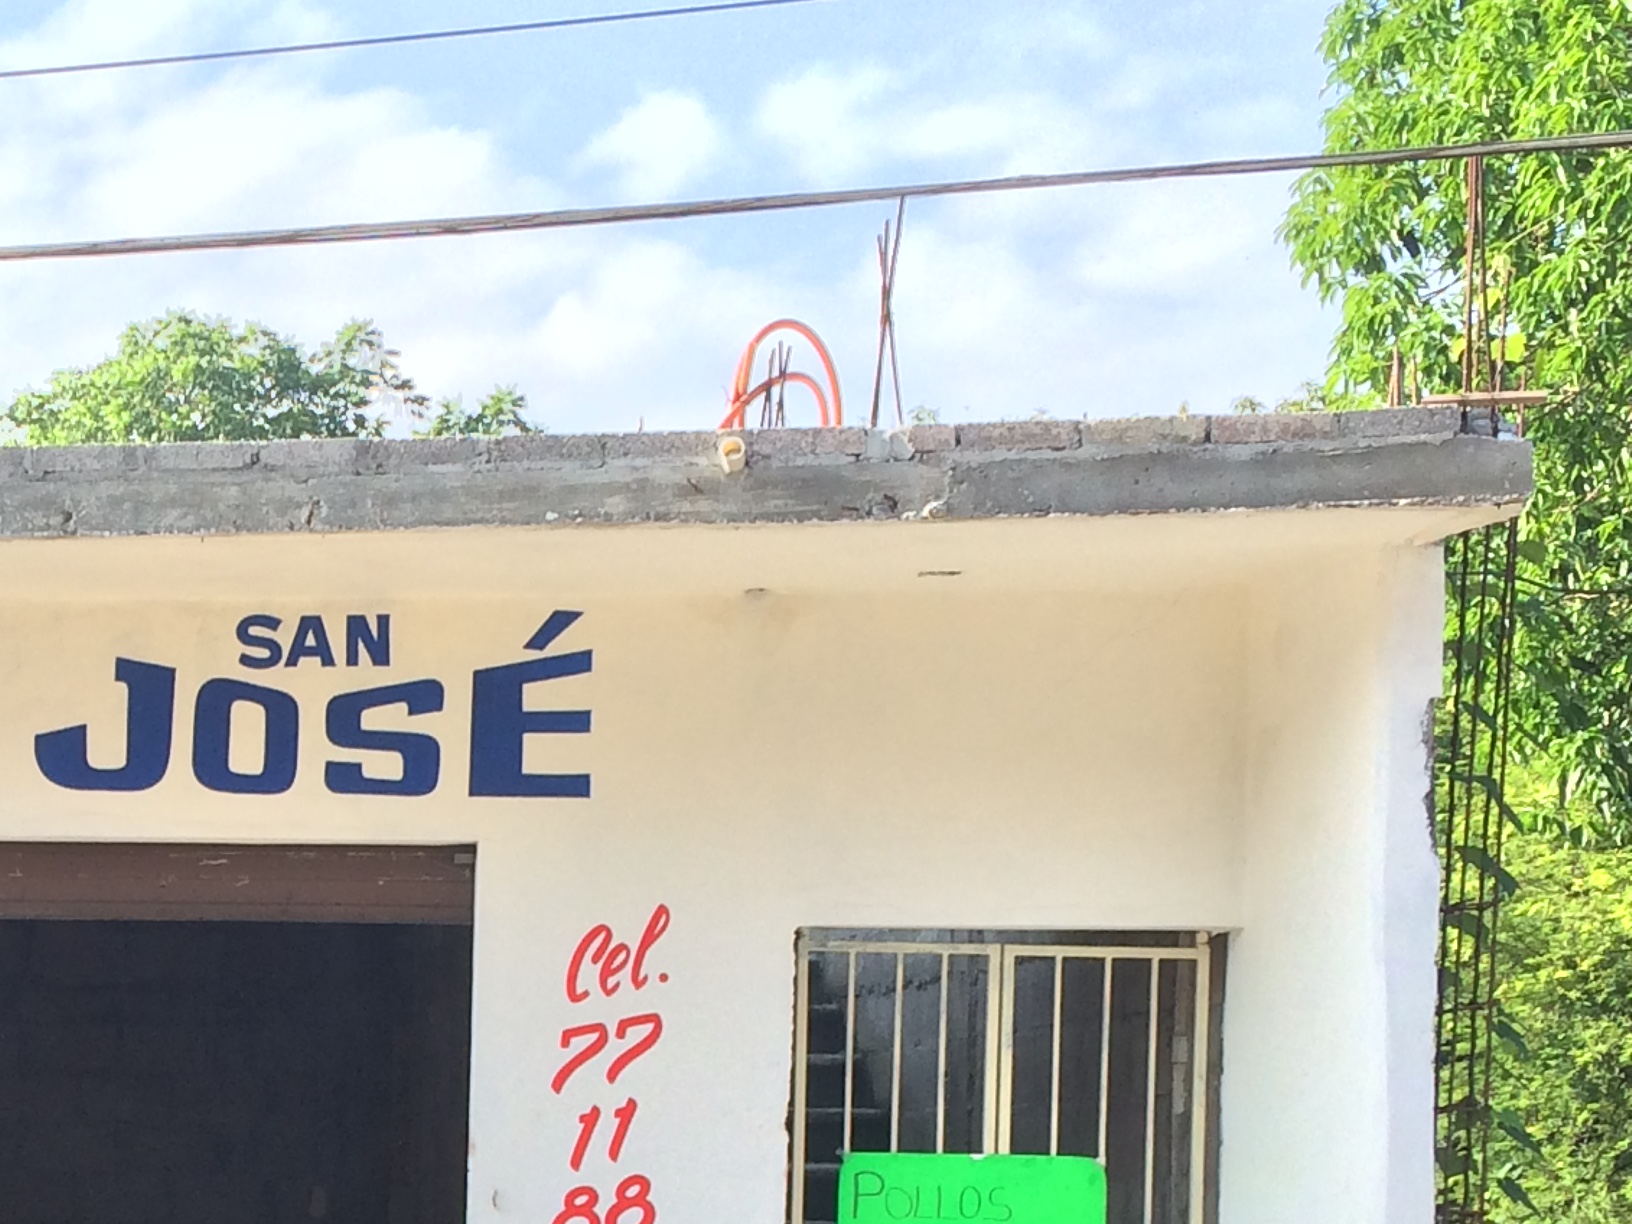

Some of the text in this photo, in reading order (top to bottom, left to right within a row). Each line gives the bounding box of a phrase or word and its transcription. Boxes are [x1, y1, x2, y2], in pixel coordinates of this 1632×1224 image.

[235, 613, 391, 669] SAN
[33, 609, 594, 798] JOSÉ
[565, 903, 670, 1004] Cel.
[550, 1012, 663, 1095] 77
[569, 1097, 638, 1172] 11
[852, 1170, 1013, 1222] POLLOS
